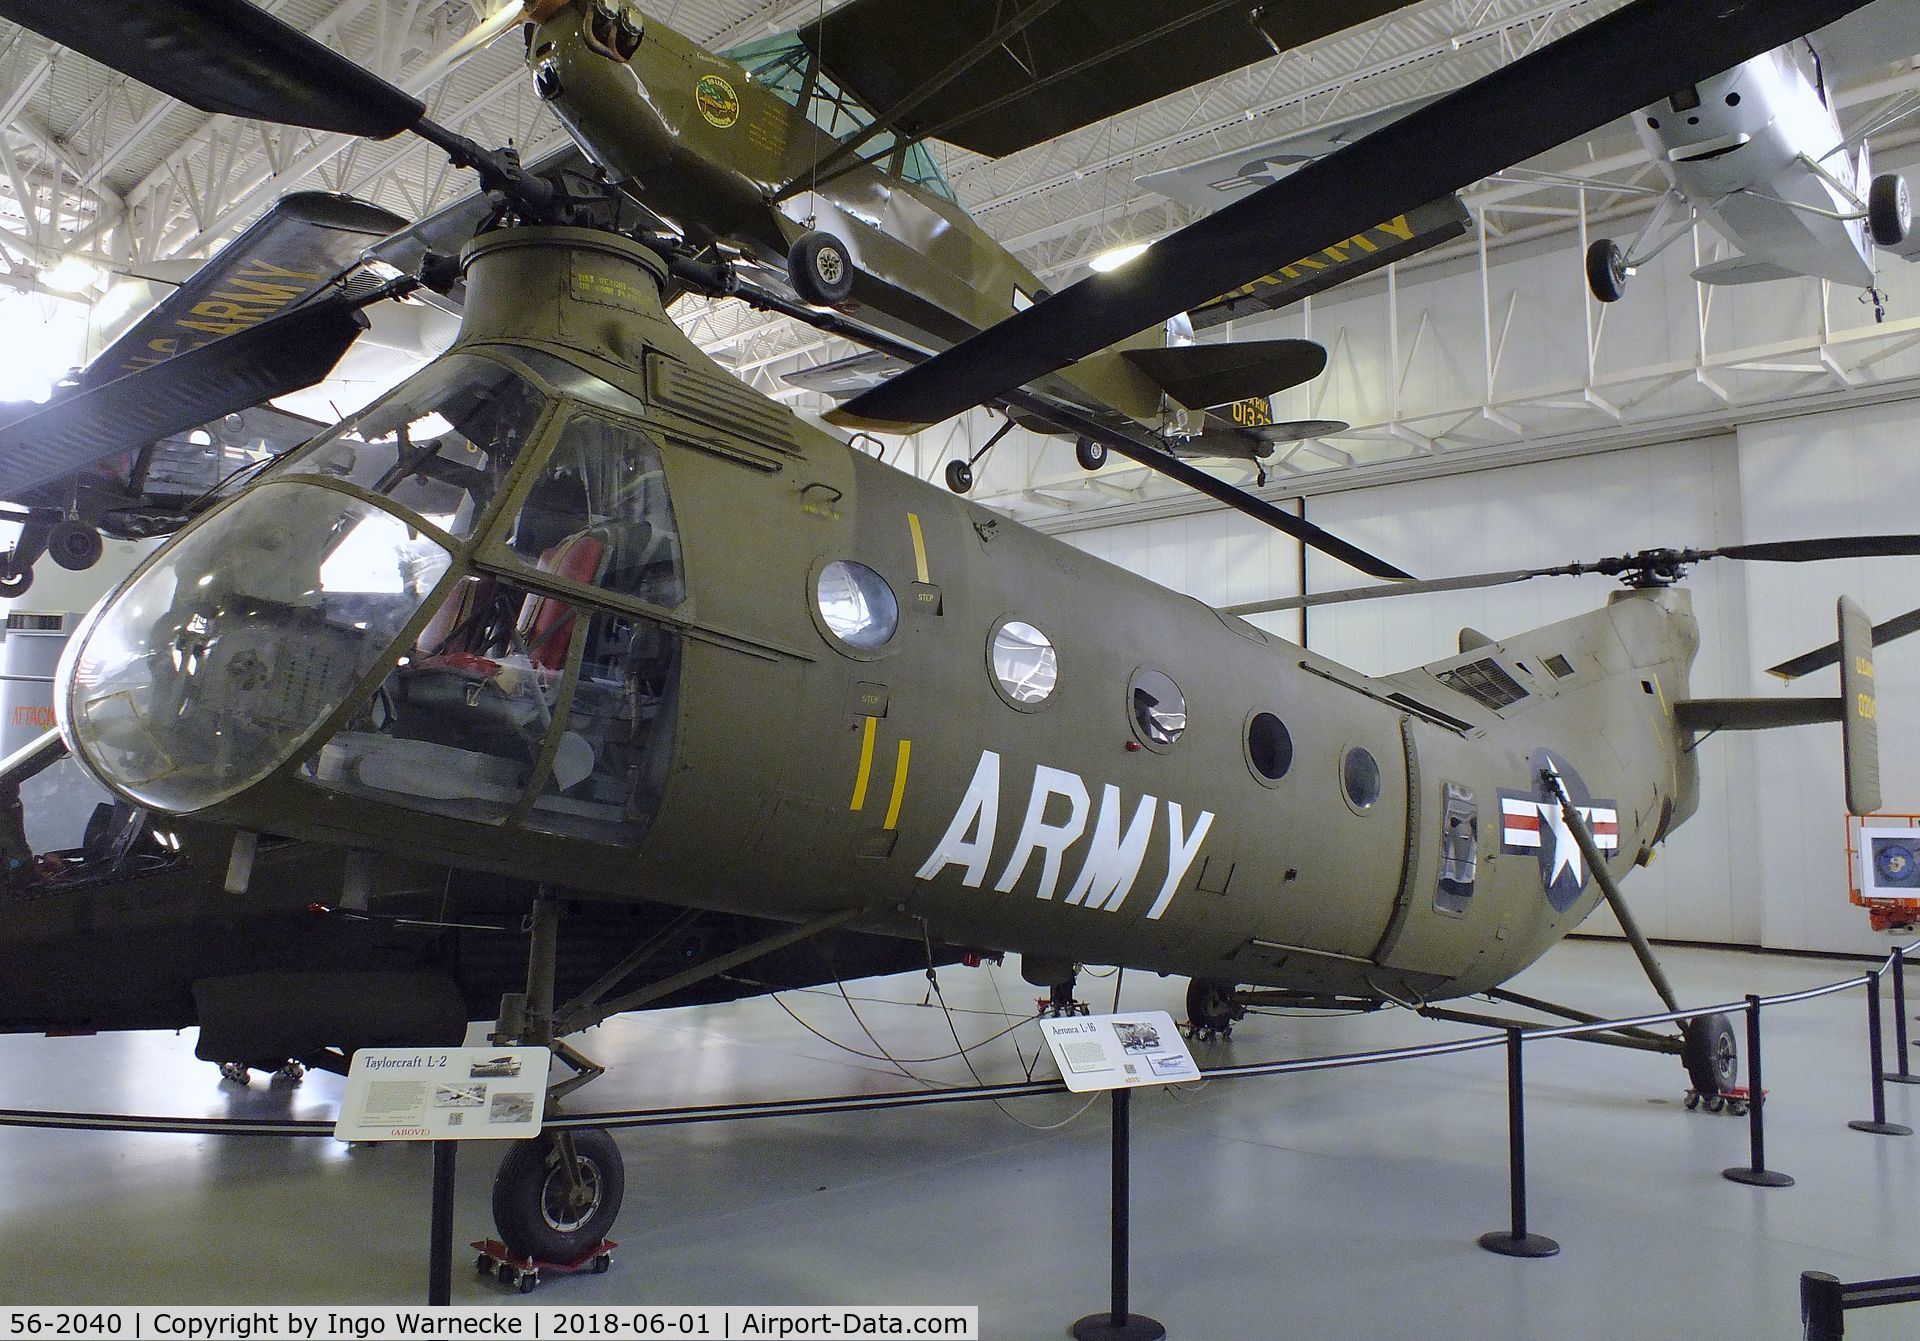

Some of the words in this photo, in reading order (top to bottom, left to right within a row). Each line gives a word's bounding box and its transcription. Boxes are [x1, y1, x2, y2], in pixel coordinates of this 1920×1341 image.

[176, 259, 325, 335] ARMY
[918, 593, 934, 602] STEP
[915, 749, 1215, 920] ARMY
[1052, 1026, 1080, 1036] Aeronca
[1080, 1022, 1097, 1033] L-16
[365, 1056, 422, 1070] Taylorcraft
[427, 1055, 448, 1068] L-2
[391, 1128, 431, 1136] (ABOVE)
